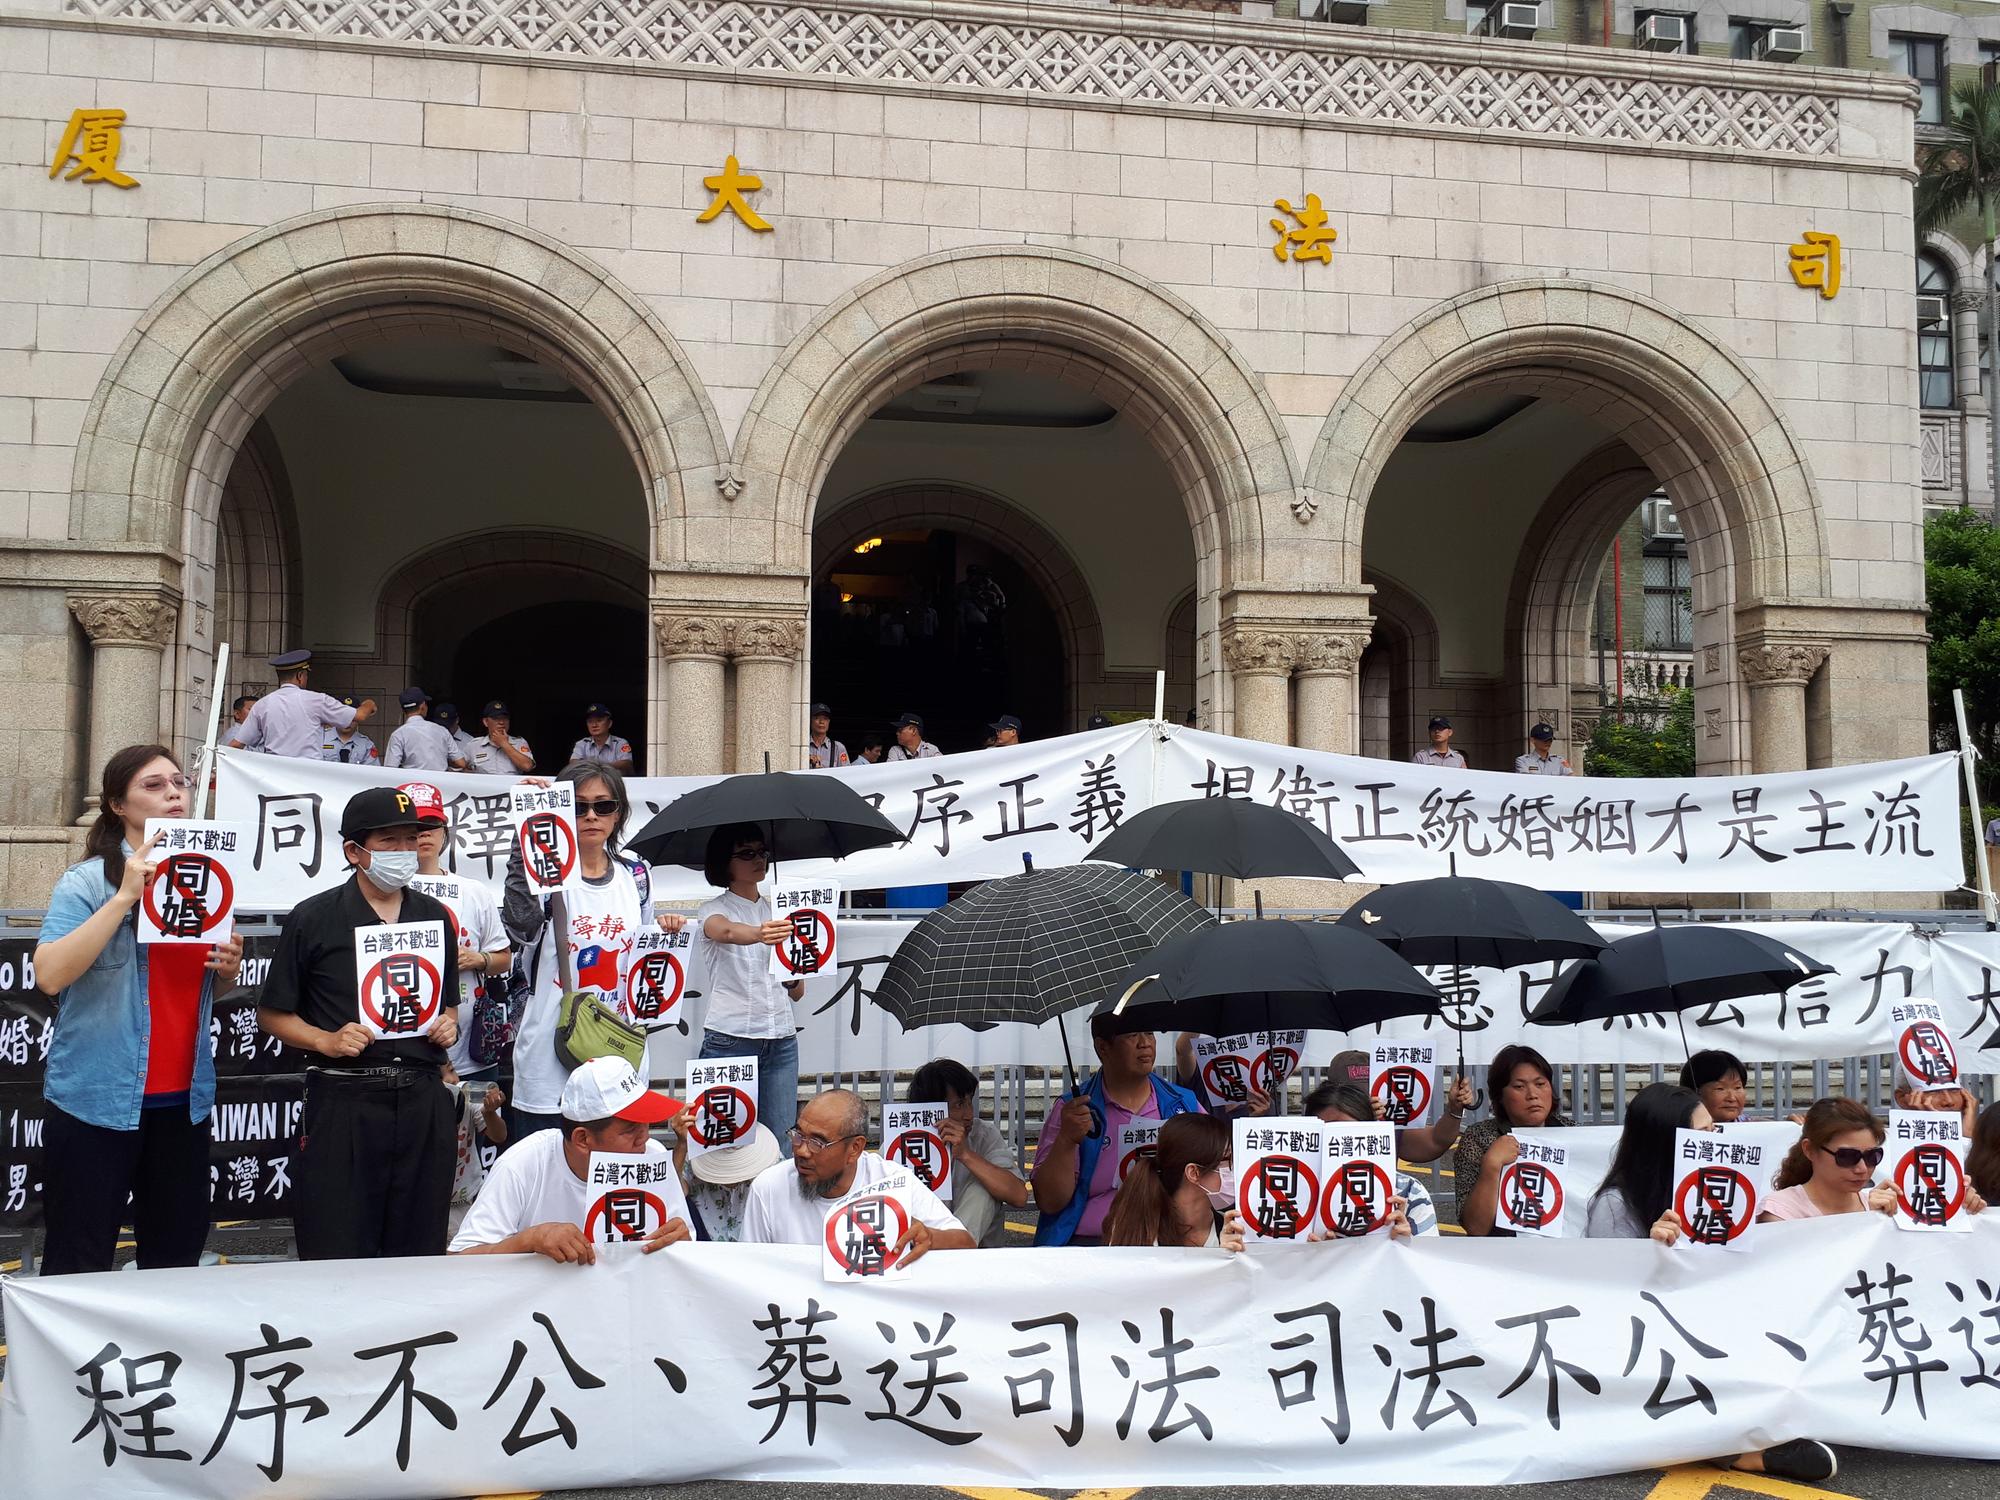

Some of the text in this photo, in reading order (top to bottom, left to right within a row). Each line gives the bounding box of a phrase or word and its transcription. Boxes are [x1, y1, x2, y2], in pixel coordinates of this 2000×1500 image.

[396, 794, 410, 813] P
[515, 790, 571, 811] 台灣不歡迎
[153, 828, 236, 852] 台灣不歡迎
[527, 814, 564, 888] 同婚
[160, 855, 210, 938] 同婚
[410, 880, 459, 899] 灣不歡迎
[776, 889, 832, 908] 台灣不歡迎
[364, 929, 439, 954] 台灣不歡迎
[572, 914, 626, 941] 寧靜
[637, 932, 690, 950] 台灣不歡迎
[790, 910, 819, 976] 同婚
[381, 955, 421, 1034] 同婚
[635, 953, 671, 1020] 同婚
[1197, 1034, 1249, 1056] 台灣不歡迎
[1375, 1047, 1433, 1063] 台灣不歡迎
[1910, 1023, 1956, 1086] 同婚
[692, 1064, 753, 1085] 台灣不歡迎
[1211, 1060, 1248, 1102] 同婚
[1384, 1068, 1413, 1126] 同婚
[210, 1101, 277, 1142] AIWAN
[704, 1088, 737, 1149] 同婚
[1897, 1119, 1960, 1141] 台灣不歡迎
[1123, 1126, 1161, 1144] 台灣不
[1246, 1129, 1320, 1152] 台灣不歡迎
[1328, 1135, 1391, 1158] 台灣不歡迎
[1518, 1142, 1565, 1165] 灣不歡迎
[1682, 1138, 1761, 1166] 台灣不歡迎
[593, 1161, 667, 1185] 台灣不歡迎
[1911, 1146, 1948, 1227] 同婚
[1257, 1157, 1300, 1239] 同婚
[1337, 1163, 1375, 1236] 同婚
[1510, 1162, 1546, 1231] 同婚
[1690, 1167, 1738, 1246] 同婚
[605, 1192, 647, 1242] 同
[845, 1195, 886, 1276] 同婚
